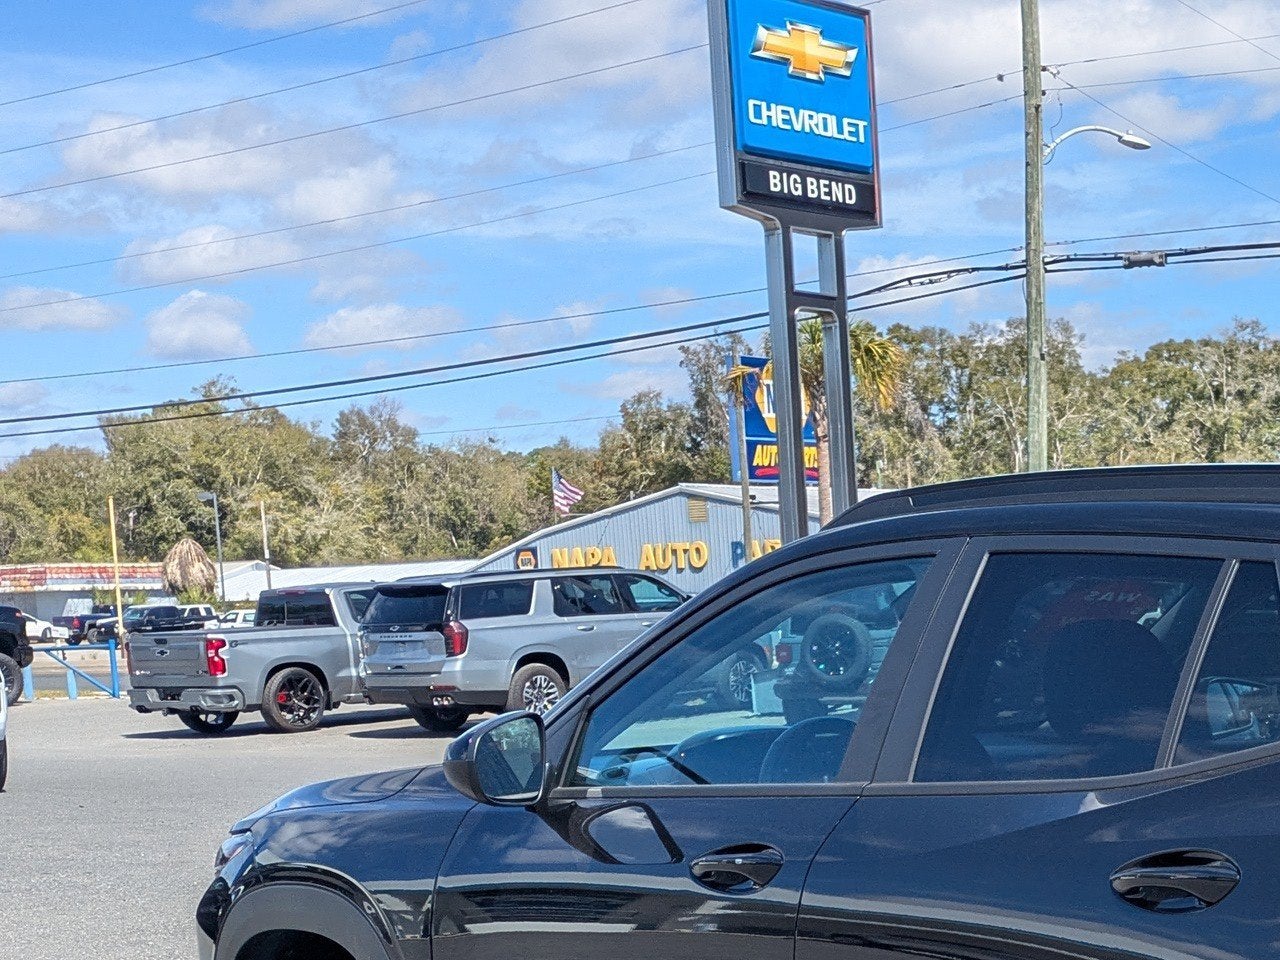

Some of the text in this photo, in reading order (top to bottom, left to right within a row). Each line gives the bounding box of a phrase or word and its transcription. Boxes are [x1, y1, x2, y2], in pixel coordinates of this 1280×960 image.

[747, 99, 868, 144] CHEVROLET
[768, 170, 857, 205] BIG BEND
[753, 445, 779, 466] AUT
[551, 546, 618, 569] NAPA
[639, 540, 709, 570] AUTO
